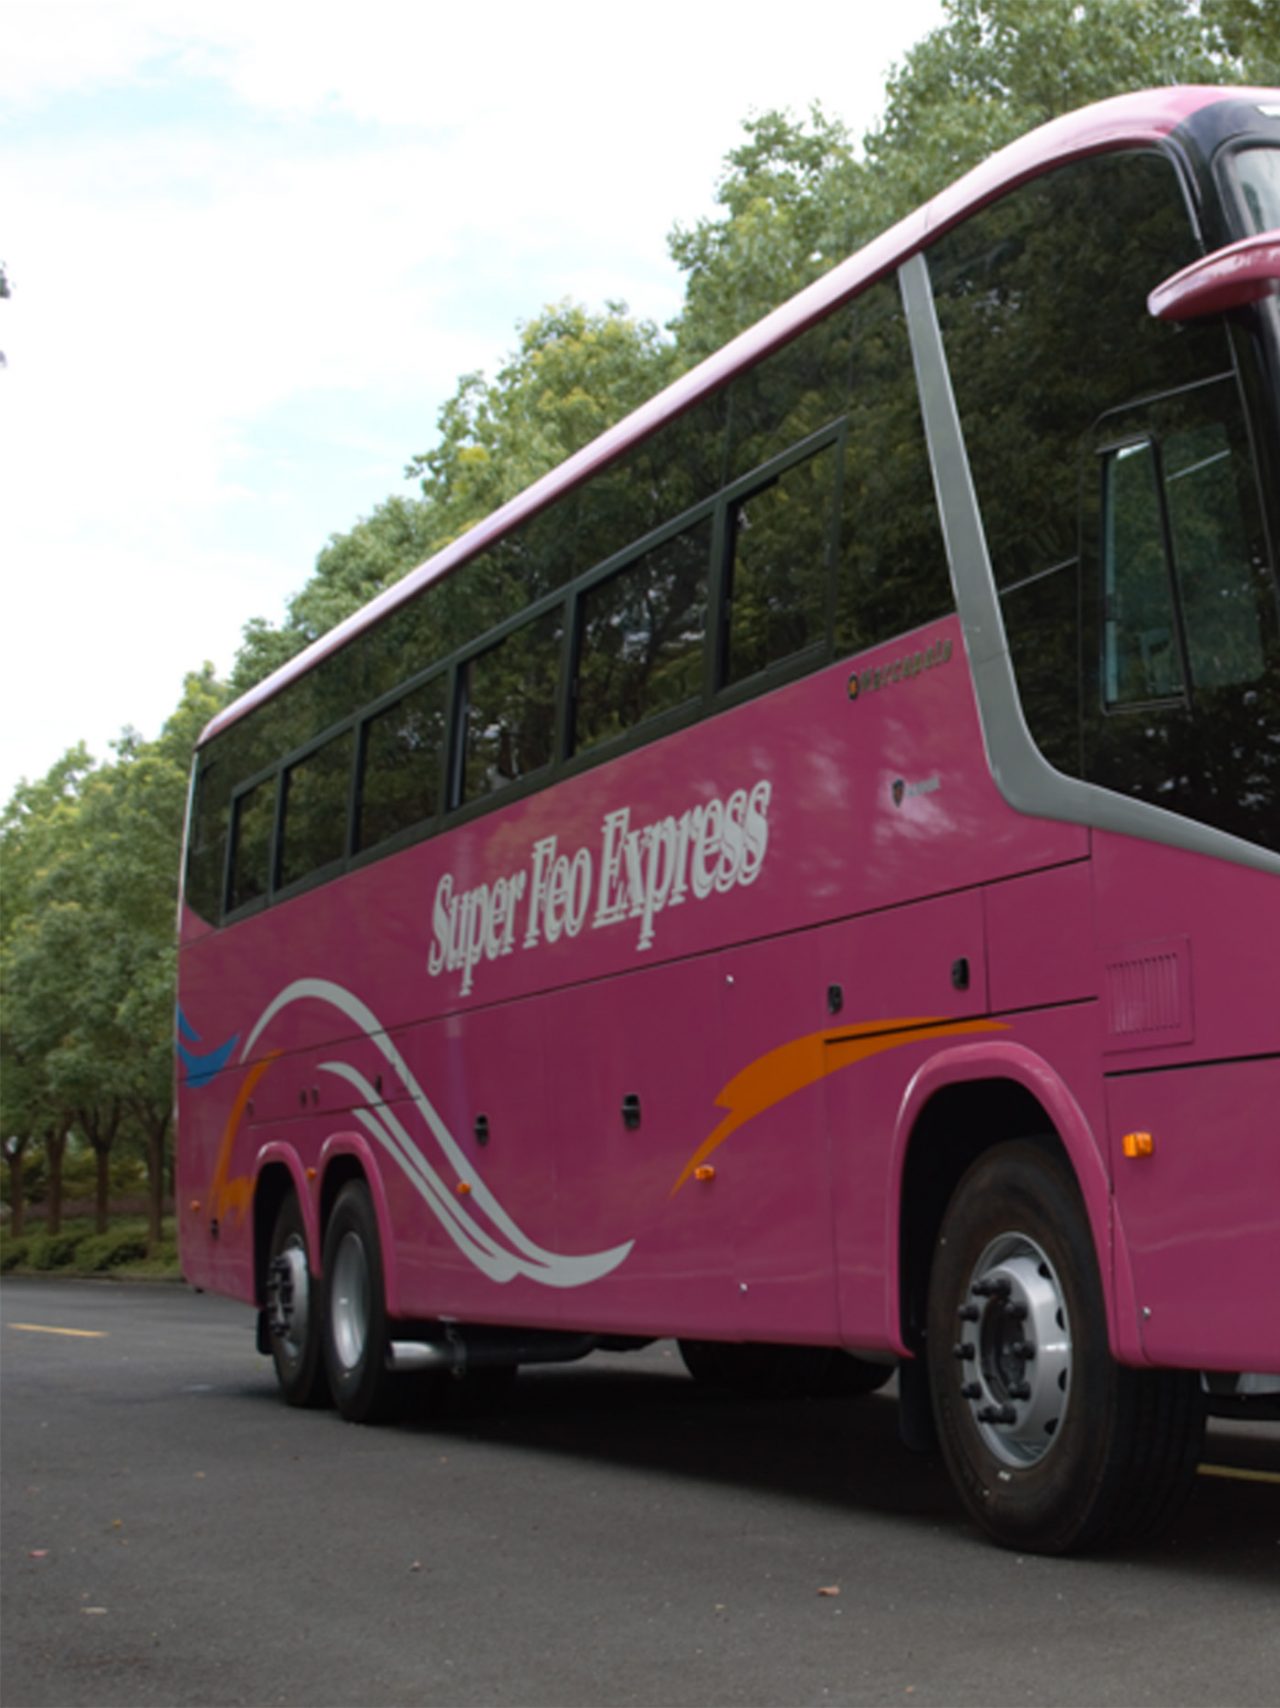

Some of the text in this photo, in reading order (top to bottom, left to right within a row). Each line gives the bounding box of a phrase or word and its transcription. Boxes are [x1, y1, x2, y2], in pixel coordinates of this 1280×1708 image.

[427, 779, 772, 997] Super Feo Express
